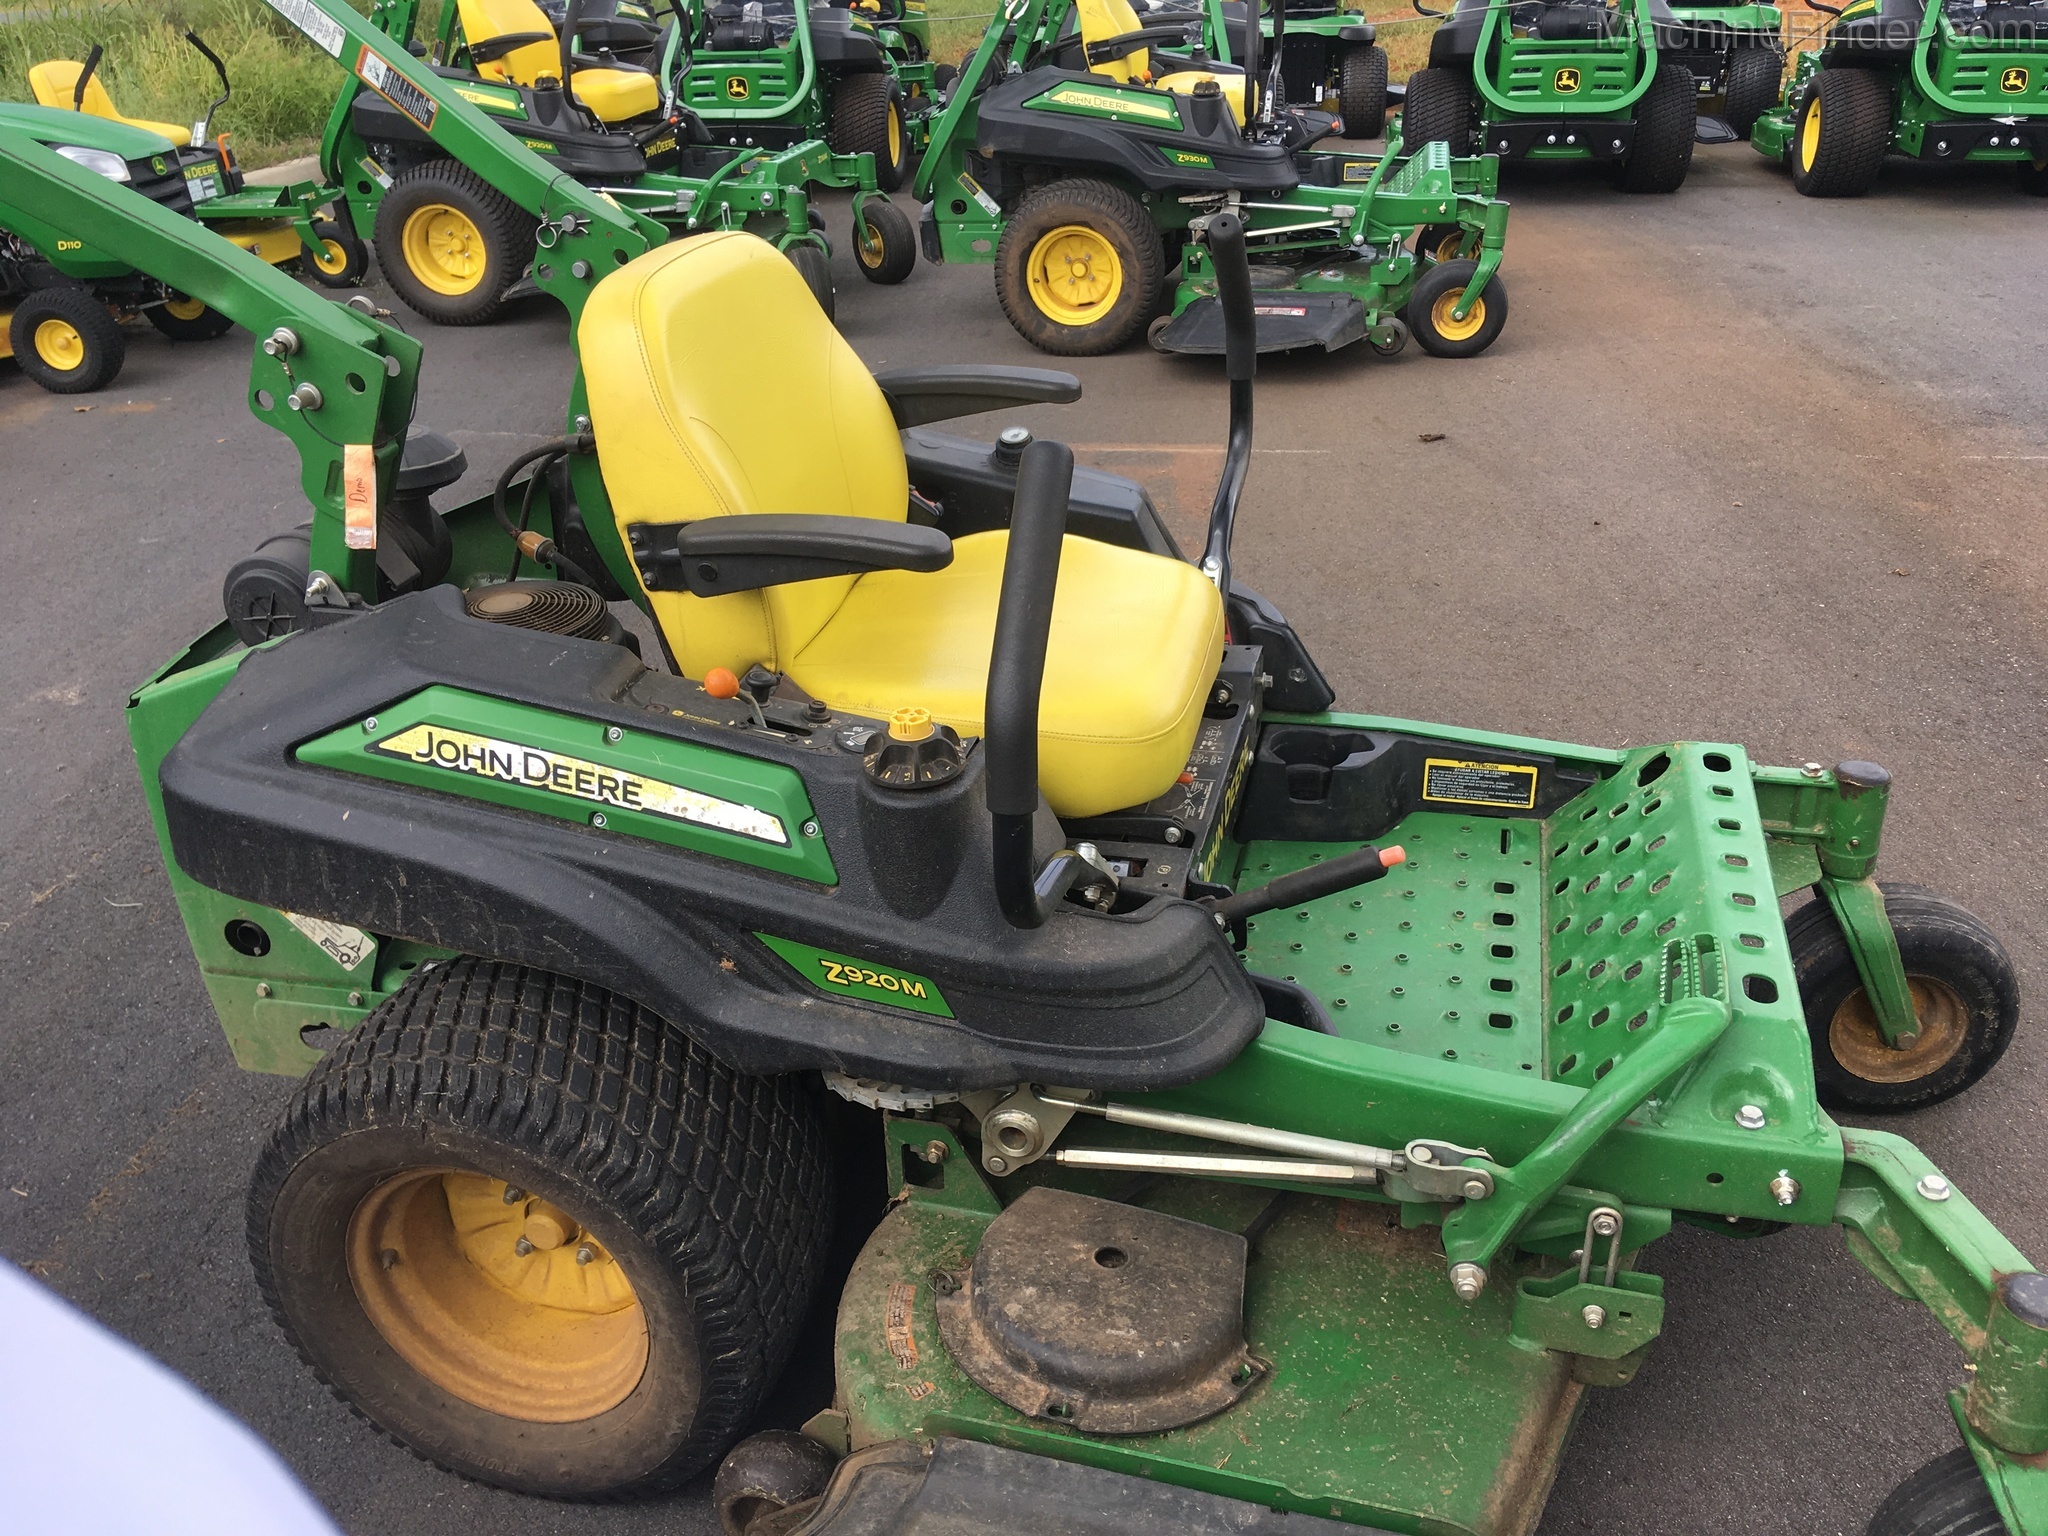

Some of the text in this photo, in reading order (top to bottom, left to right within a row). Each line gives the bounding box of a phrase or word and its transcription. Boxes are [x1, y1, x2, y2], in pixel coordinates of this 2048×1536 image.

[1062, 92, 1129, 111] JOHN DEERE
[656, 137, 677, 154] DEERE
[1176, 153, 1209, 164] Z930M
[191, 163, 219, 178] DEERE
[57, 240, 82, 251] D110
[414, 731, 644, 807] JOHN DEERE
[818, 957, 928, 1000] Z920M
